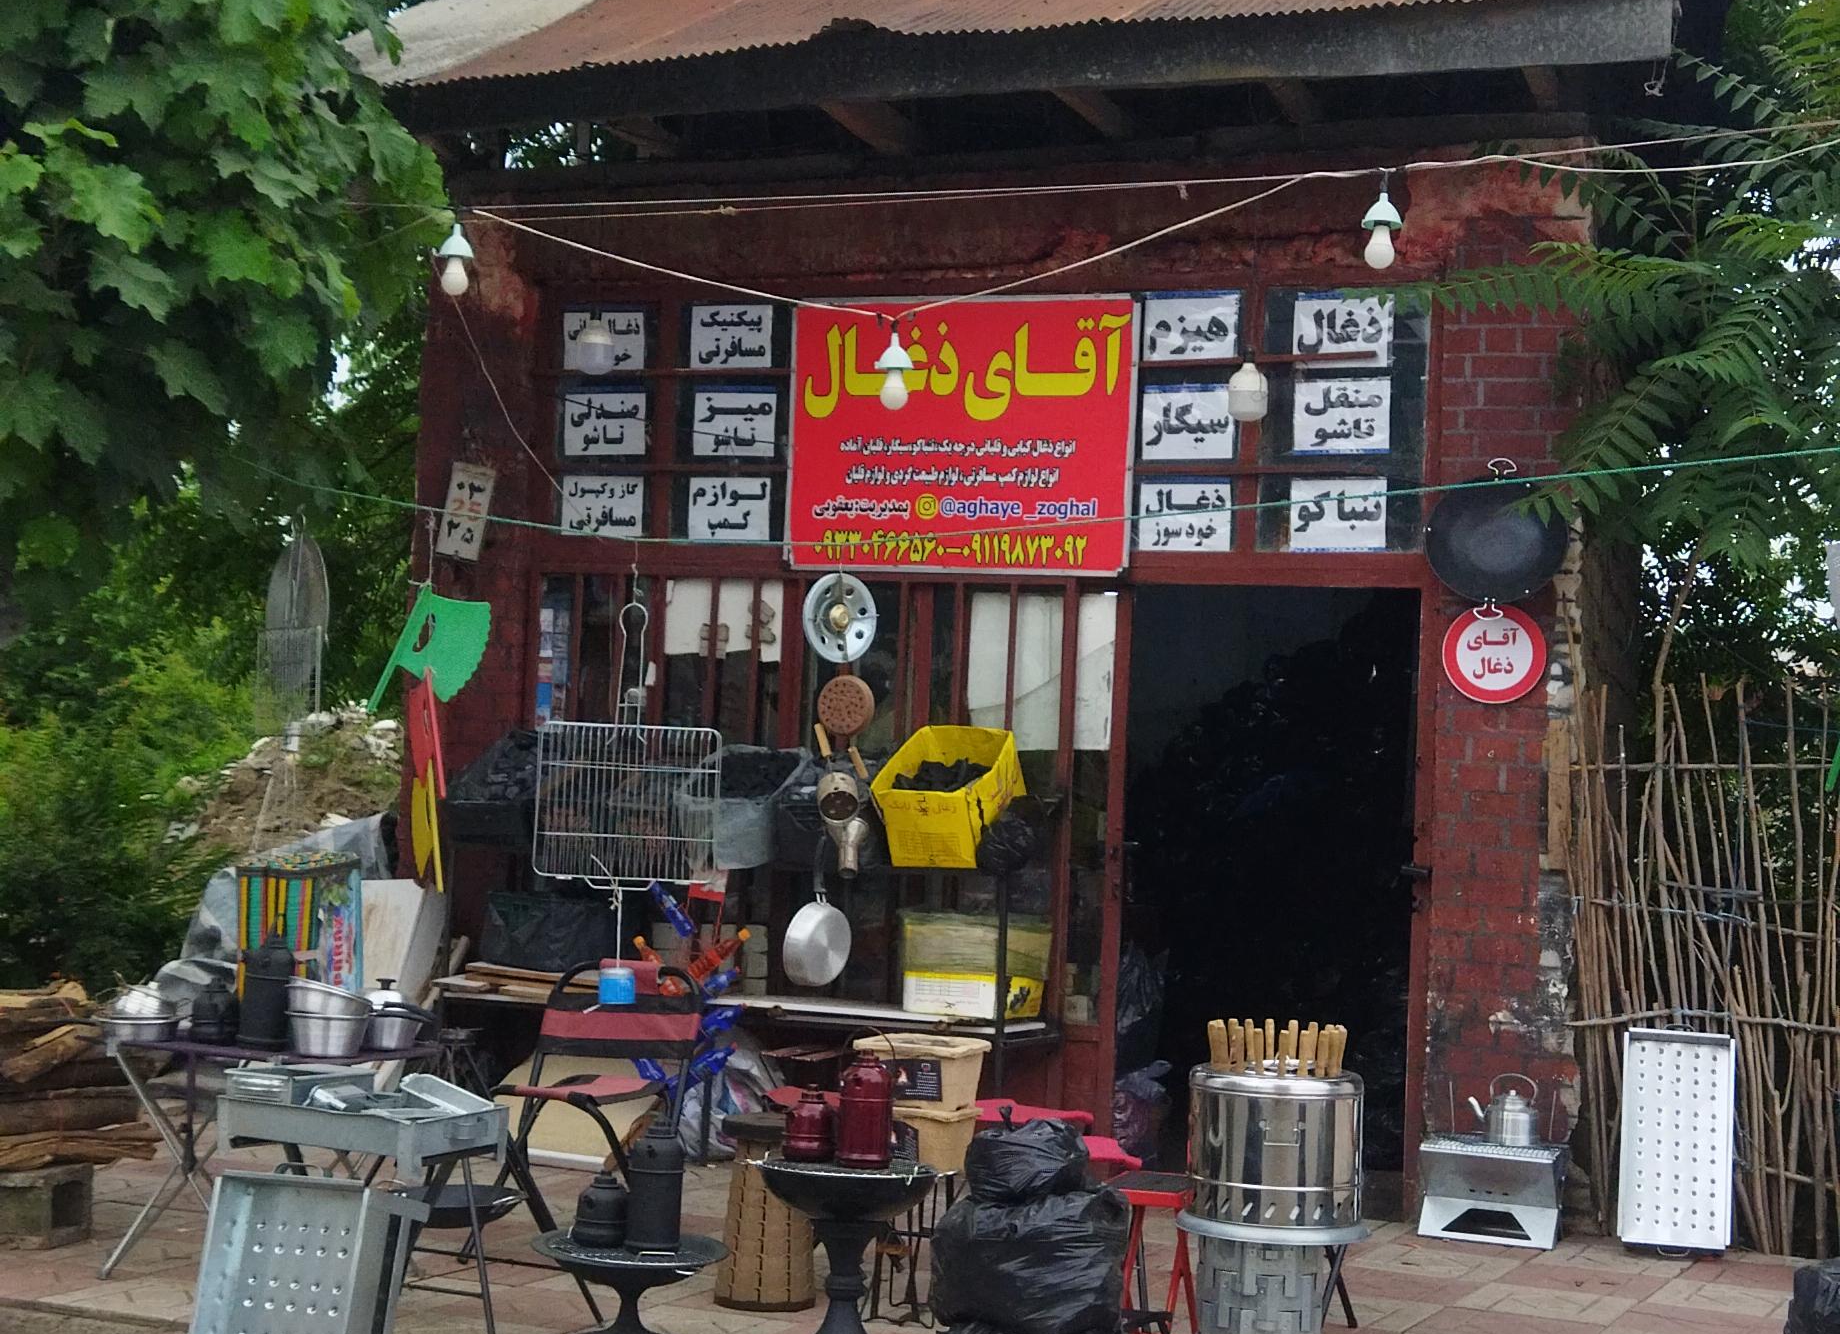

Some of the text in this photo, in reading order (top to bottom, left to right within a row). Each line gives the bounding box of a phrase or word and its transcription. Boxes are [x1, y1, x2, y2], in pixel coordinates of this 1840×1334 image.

[700, 310, 762, 333] پیکنیک
[1148, 314, 1230, 355] هیزم
[1296, 306, 1383, 354] ذغال
[698, 336, 766, 364] مسافرتی
[804, 313, 1132, 421] آقای ذغال
[570, 397, 640, 427] صندلی
[698, 396, 773, 422] میز
[1304, 385, 1384, 416] منقل
[581, 424, 624, 451] تاشو
[1145, 401, 1230, 447] سیگار
[711, 426, 756, 453] تاشو
[692, 481, 768, 506] لوازم
[1144, 488, 1227, 514] ذغال
[569, 506, 637, 533] مسافرتی
[707, 511, 750, 537] کمپ
[1466, 627, 1520, 651] آقای
[1472, 656, 1514, 680] ذغال
